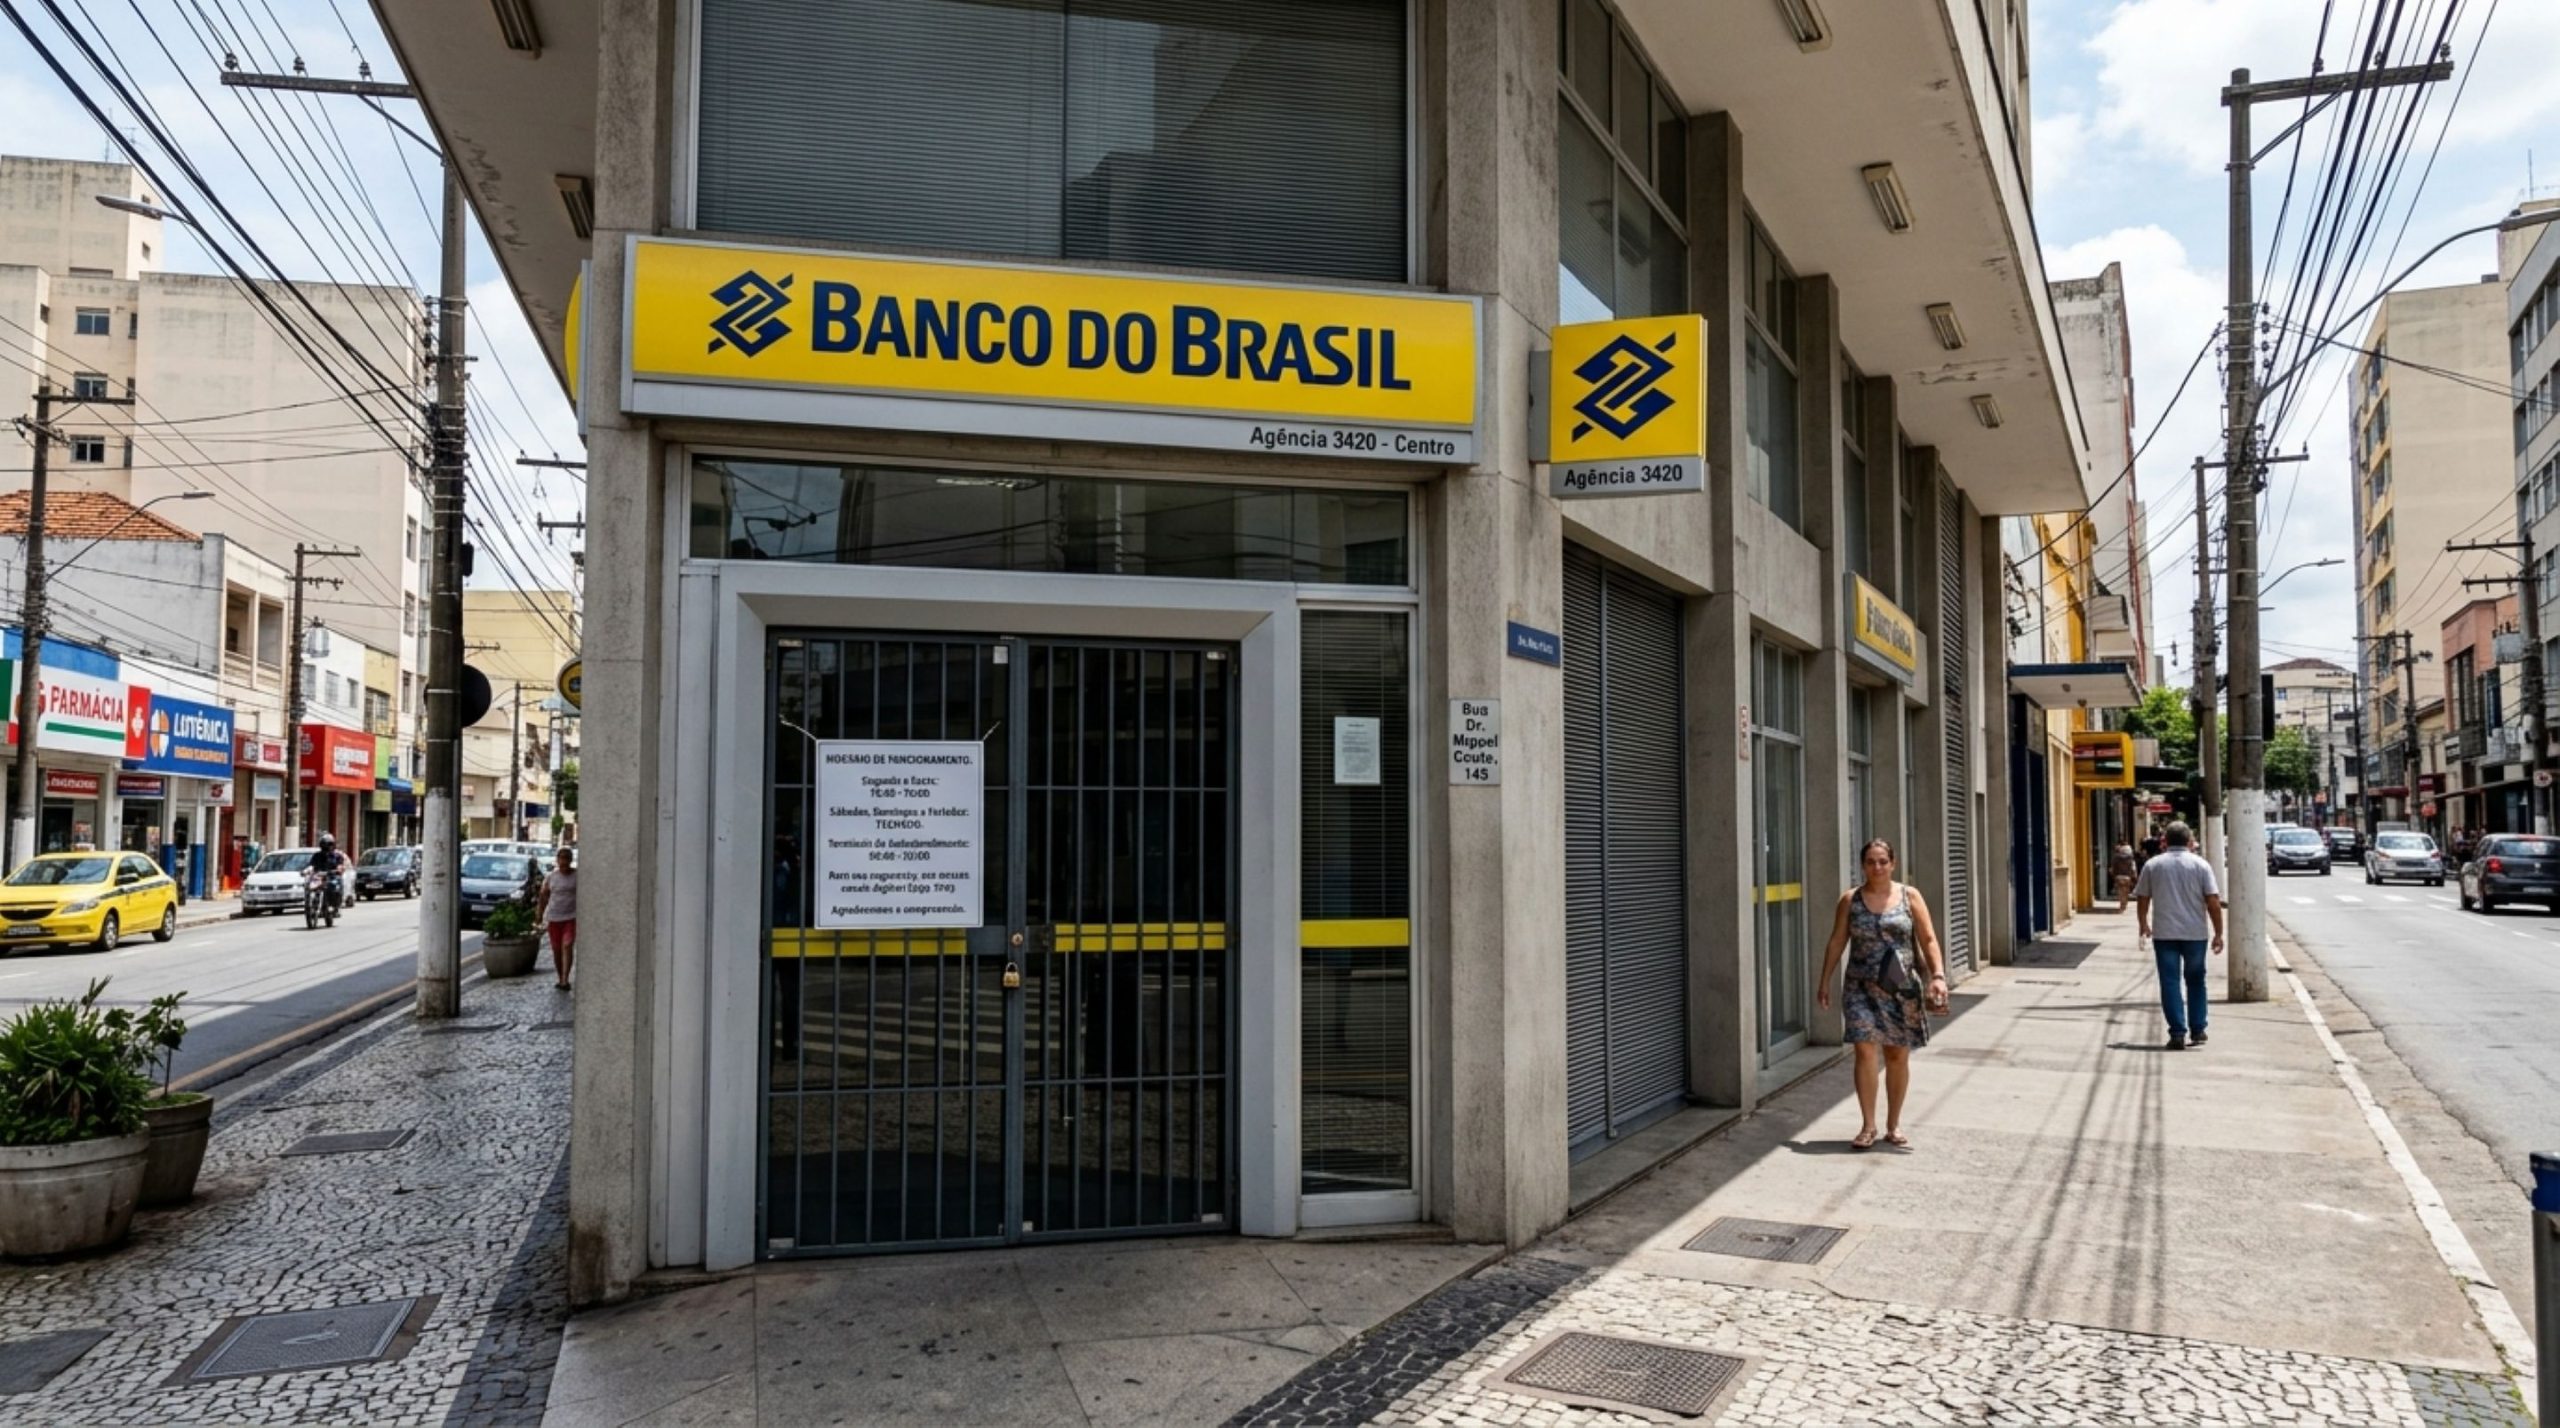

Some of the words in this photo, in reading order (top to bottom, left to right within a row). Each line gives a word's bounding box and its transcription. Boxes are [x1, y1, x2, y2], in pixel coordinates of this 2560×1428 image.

[811, 279, 1052, 367] BANCO
[1068, 309, 1157, 373] DO
[1172, 304, 1411, 391] BRASIL
[1333, 431, 1377, 451] 3420
[1394, 434, 1455, 456] Centro
[1641, 464, 1683, 483] 3420
[1466, 719, 1486, 731] Dr.
[873, 754, 886, 765] DE
